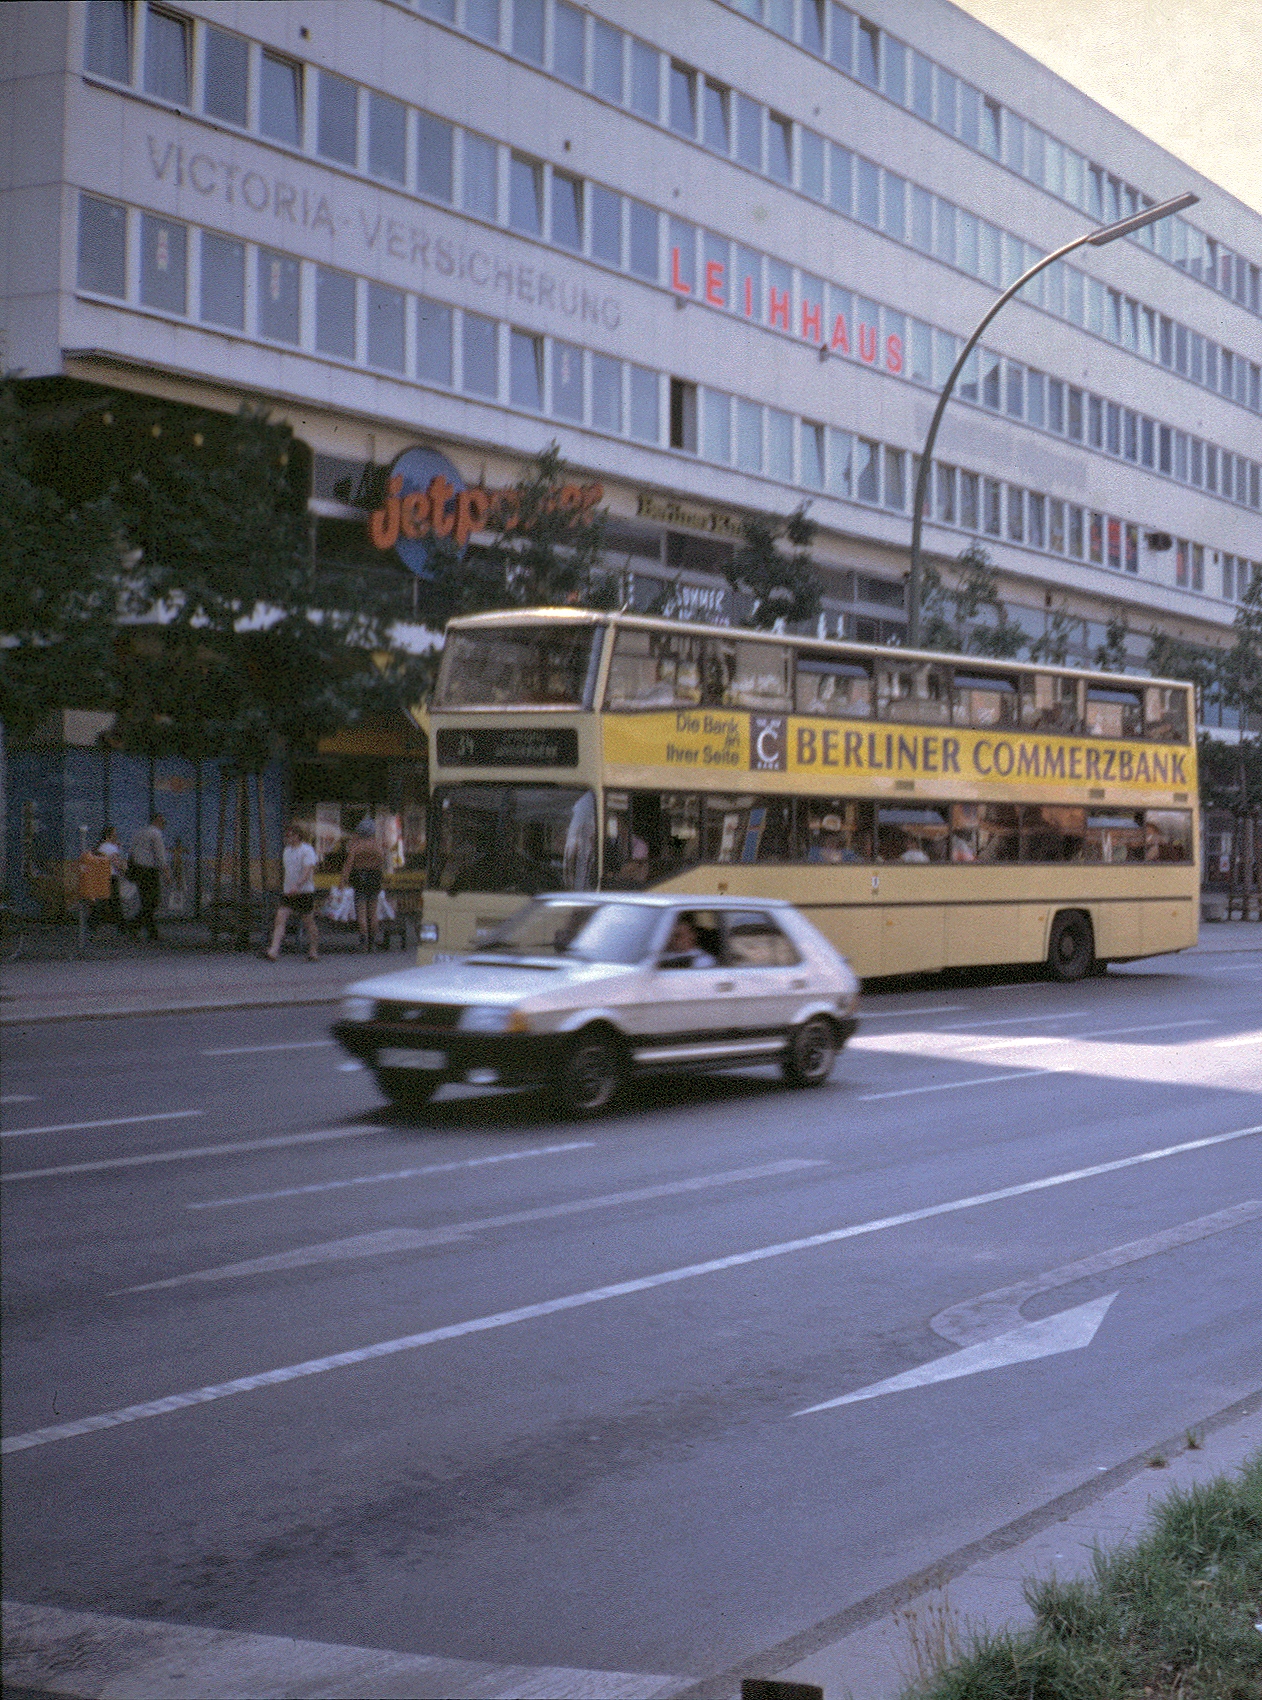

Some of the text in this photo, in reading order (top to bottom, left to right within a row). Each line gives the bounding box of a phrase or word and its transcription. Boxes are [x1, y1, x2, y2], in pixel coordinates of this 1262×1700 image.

[671, 246, 904, 374] LEIHHAUS
[796, 727, 1188, 785] BERLINER COMMERZBANK
